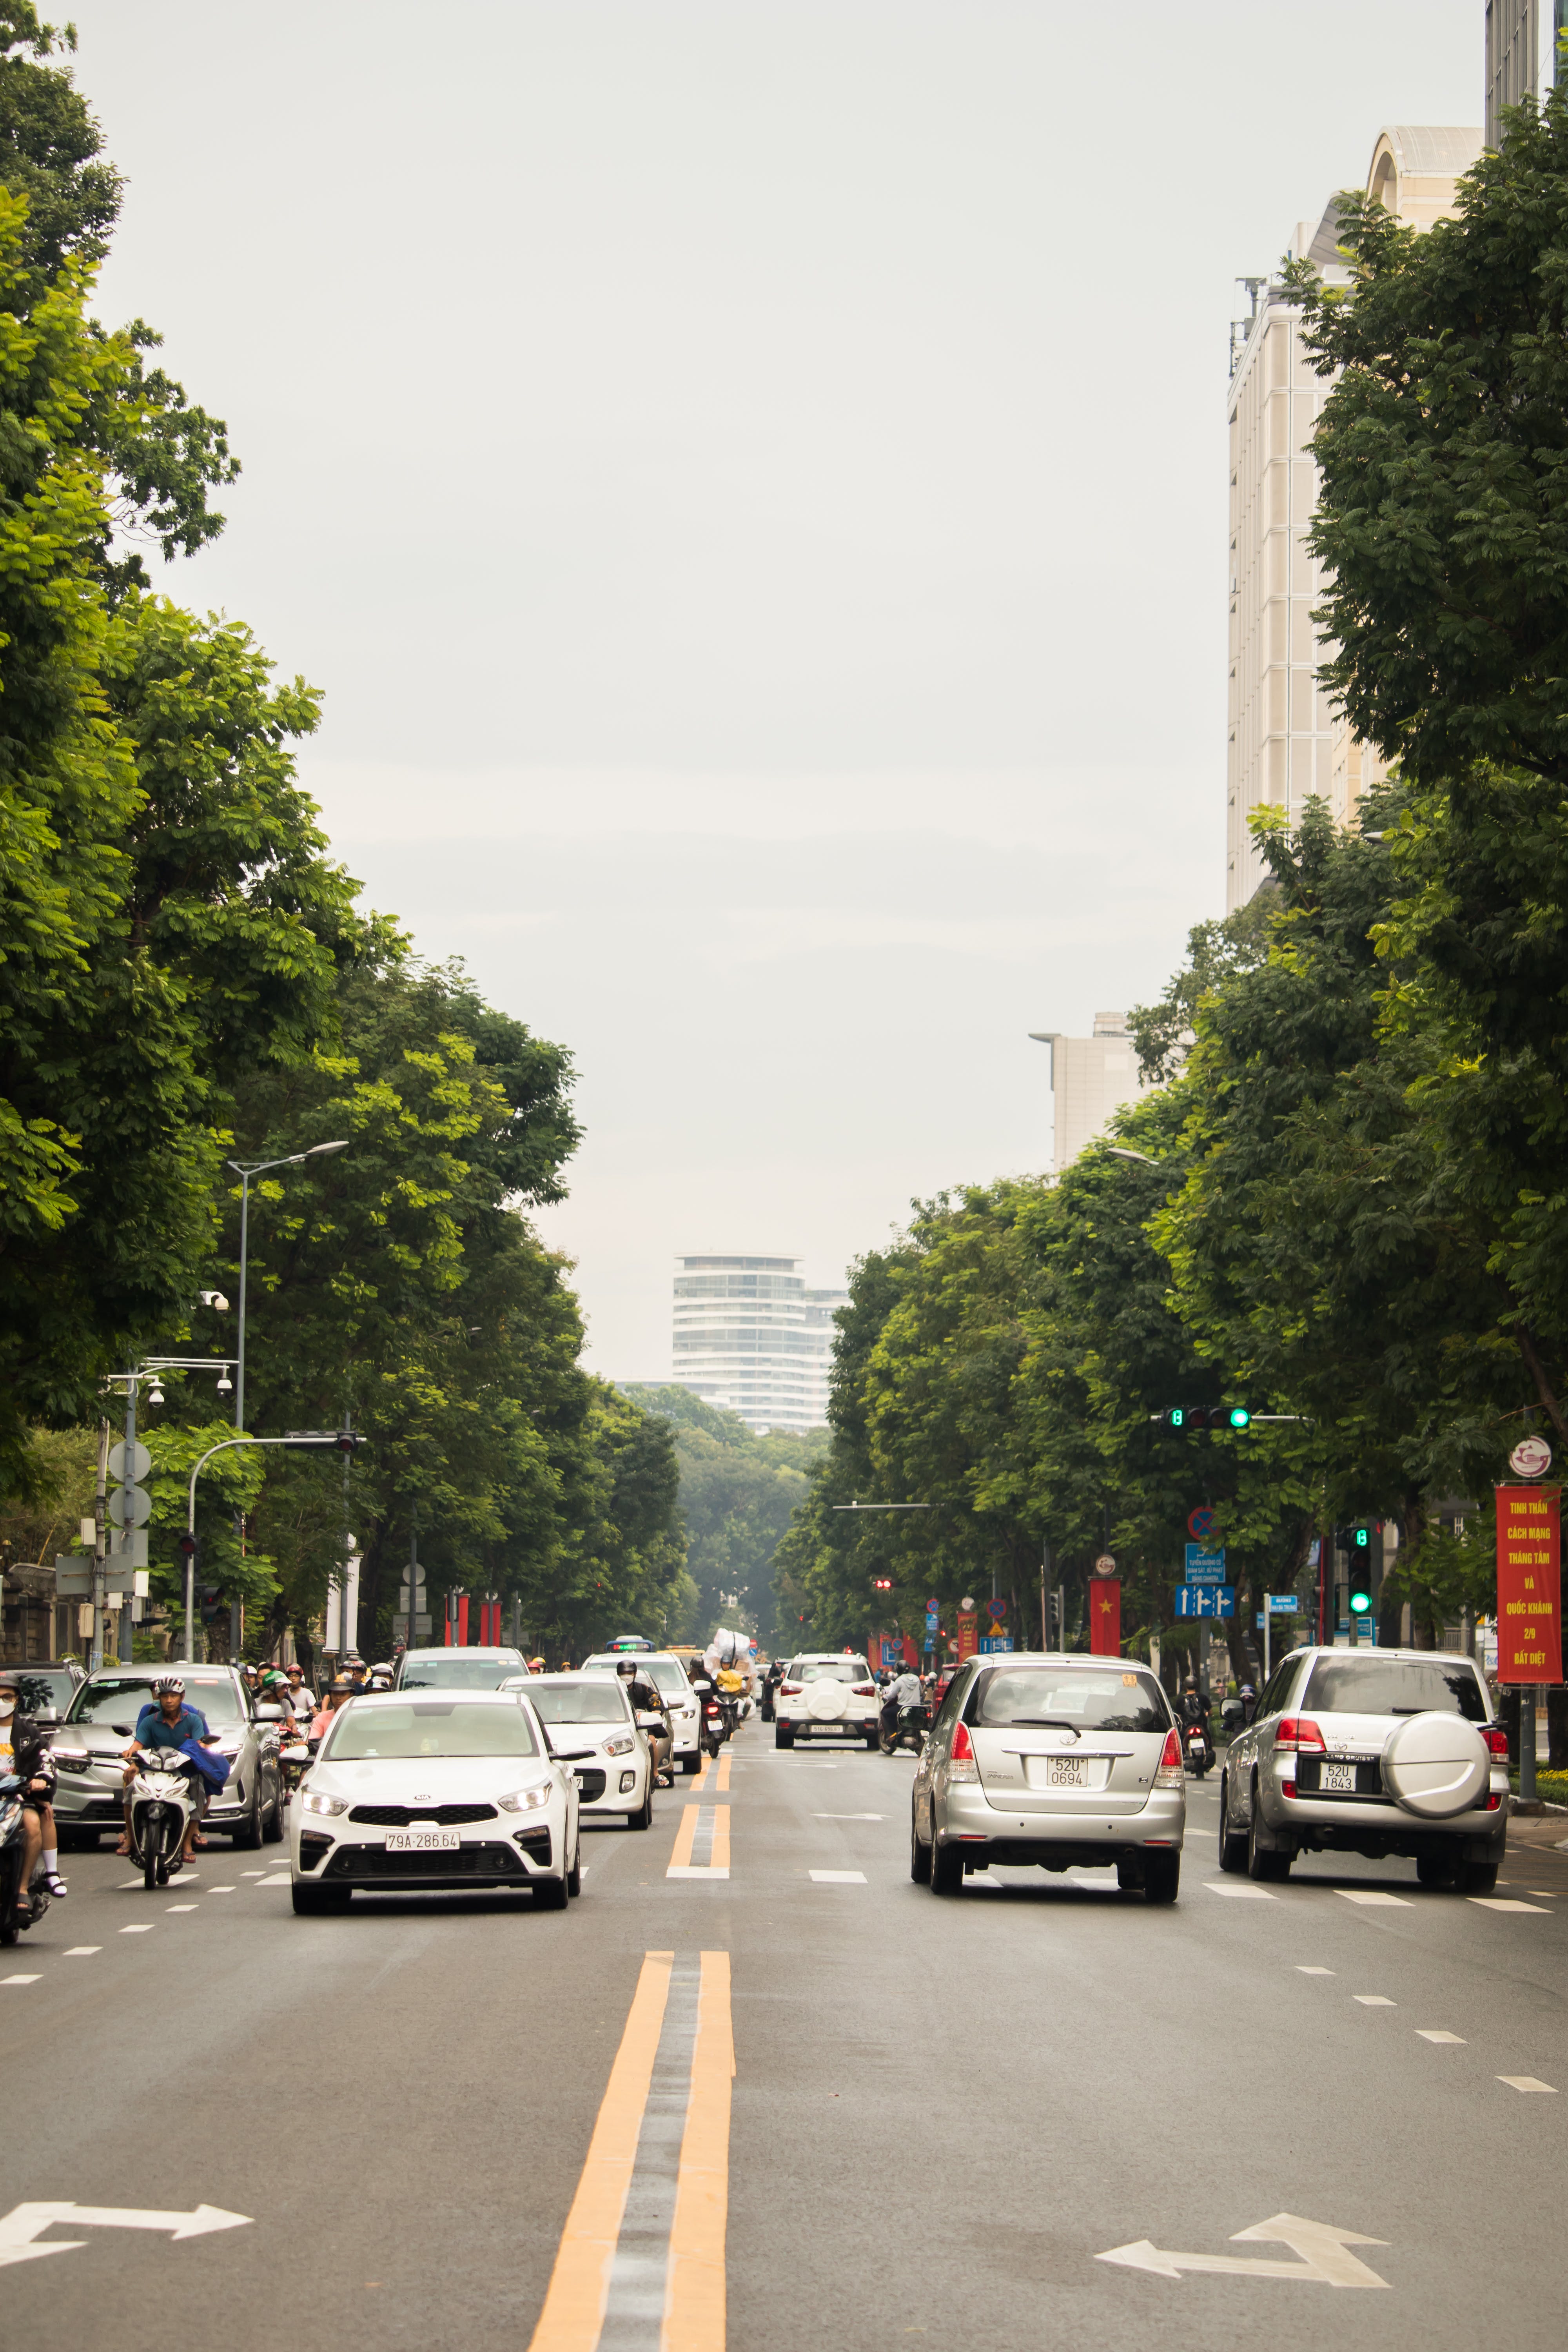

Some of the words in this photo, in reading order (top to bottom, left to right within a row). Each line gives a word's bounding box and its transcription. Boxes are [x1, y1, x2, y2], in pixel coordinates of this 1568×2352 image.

[1510, 1502, 1527, 1514] TINH
[1508, 1525, 1527, 1539] CÁCH
[1529, 1527, 1551, 1542] MẠNG
[1508, 1550, 1532, 1564] THÁNG
[1534, 1550, 1550, 1564] TÁM
[1524, 1575, 1535, 1589] VÀ
[1506, 1599, 1526, 1615] QUỐC
[1528, 1600, 1553, 1614] KHÁNH
[1524, 1628, 1536, 1639] 2/9
[1514, 1649, 1528, 1664] BẤT
[1530, 1650, 1546, 1667] DIỆT
[1056, 1759, 1079, 1771] 52U
[1328, 1765, 1349, 1777] 52U
[1052, 1772, 1082, 1785] 0694
[1325, 1777, 1352, 1789] 1843
[389, 1834, 457, 1848] 79A-286.64
